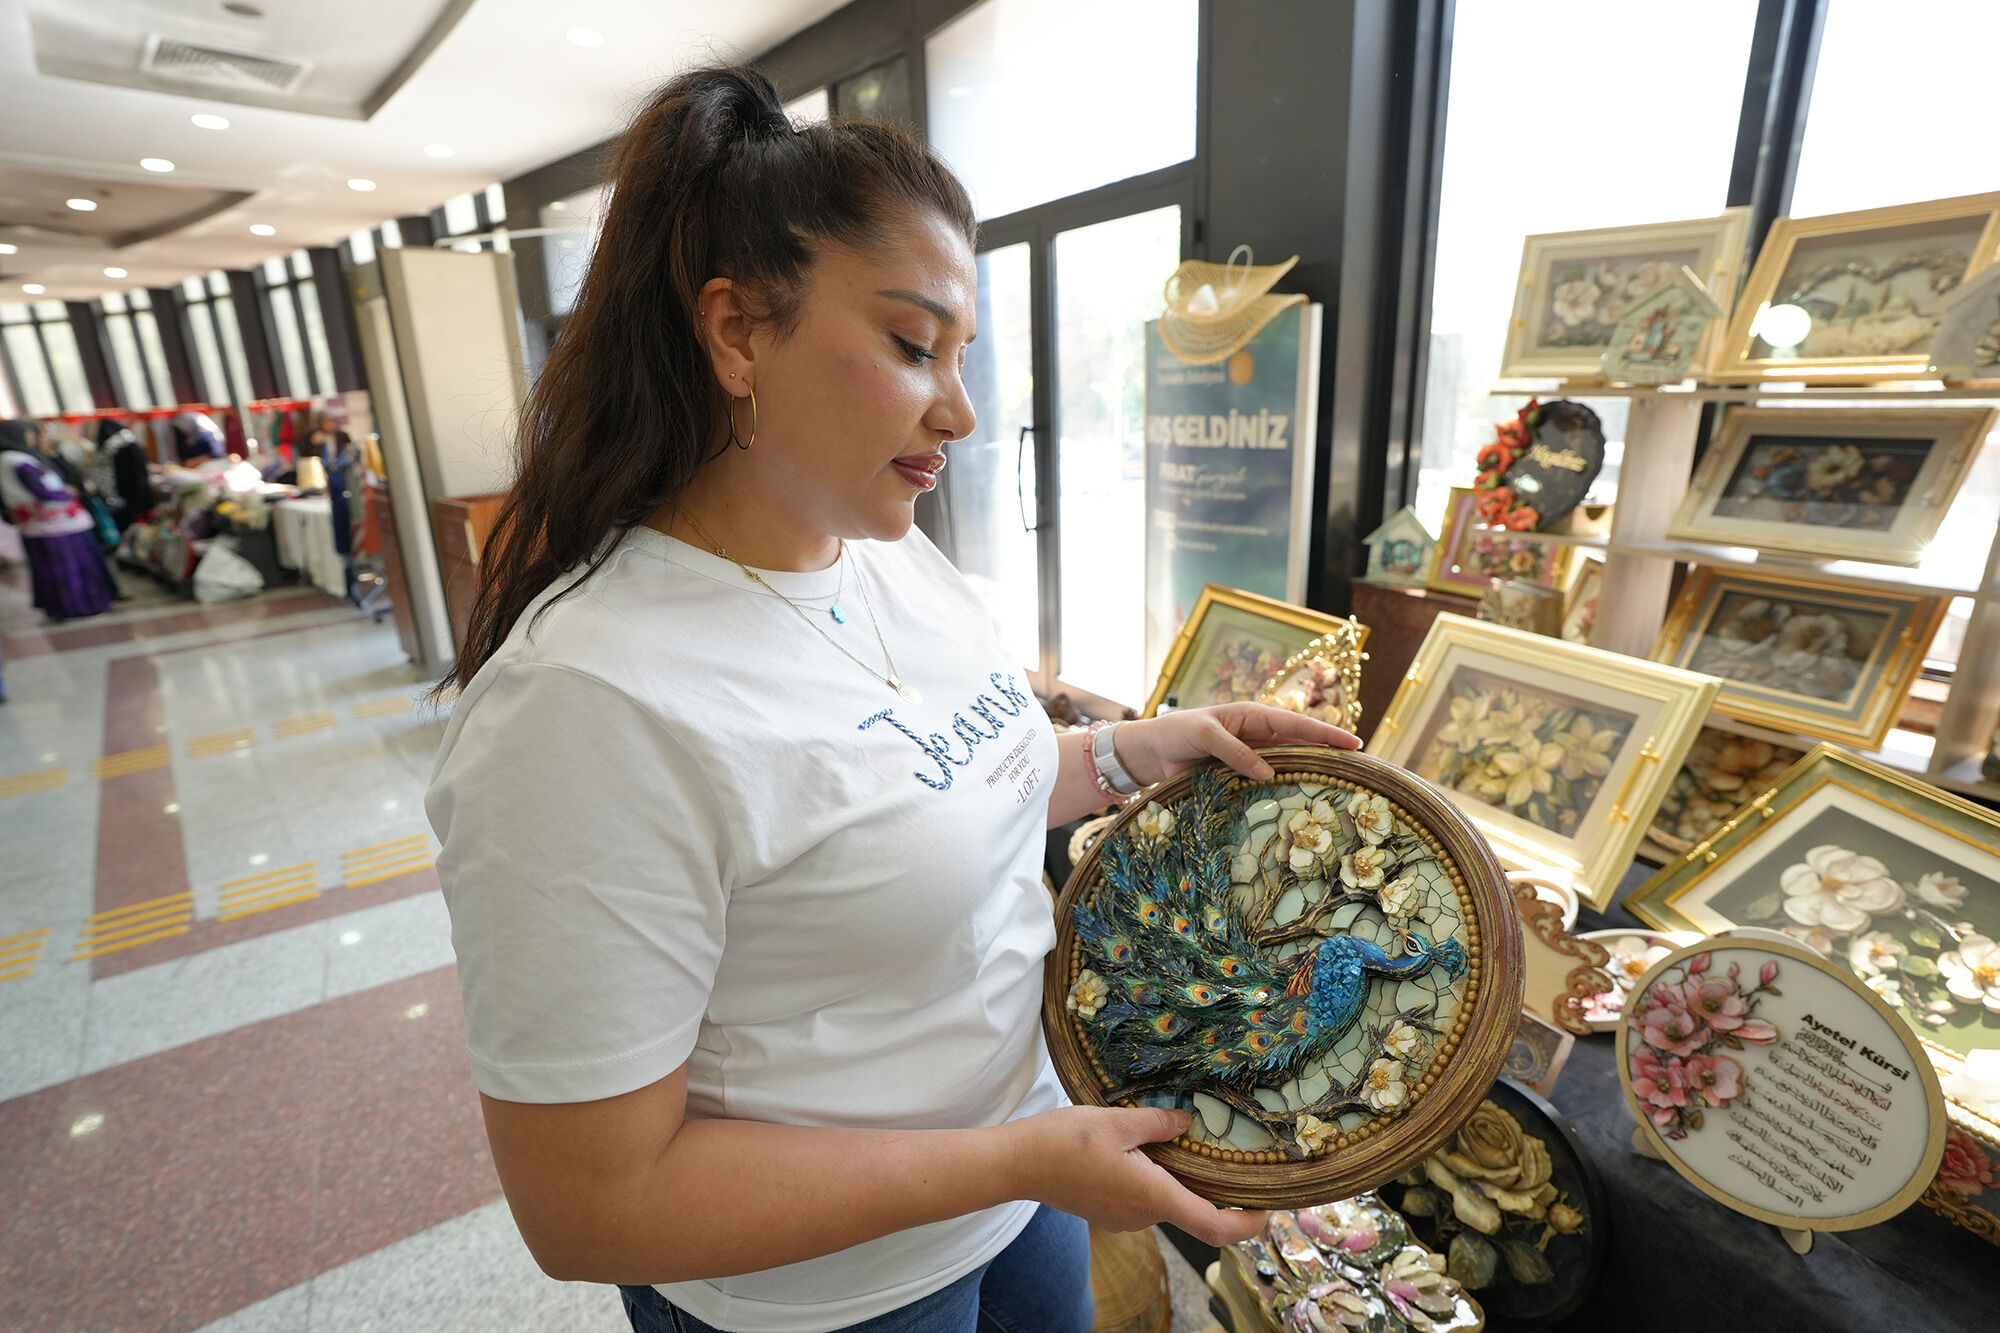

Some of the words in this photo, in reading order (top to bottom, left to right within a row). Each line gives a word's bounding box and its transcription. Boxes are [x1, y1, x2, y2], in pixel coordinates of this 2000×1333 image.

[857, 672, 1029, 790] Jeans
[986, 752, 1014, 788] PRODUCTS
[1012, 728, 1037, 758] DESIGNED
[1008, 767, 1021, 783] FOR
[1017, 754, 1030, 770] YOU
[1801, 1014, 1857, 1050] Ayetel
[1859, 1046, 1911, 1081] Kürsi
